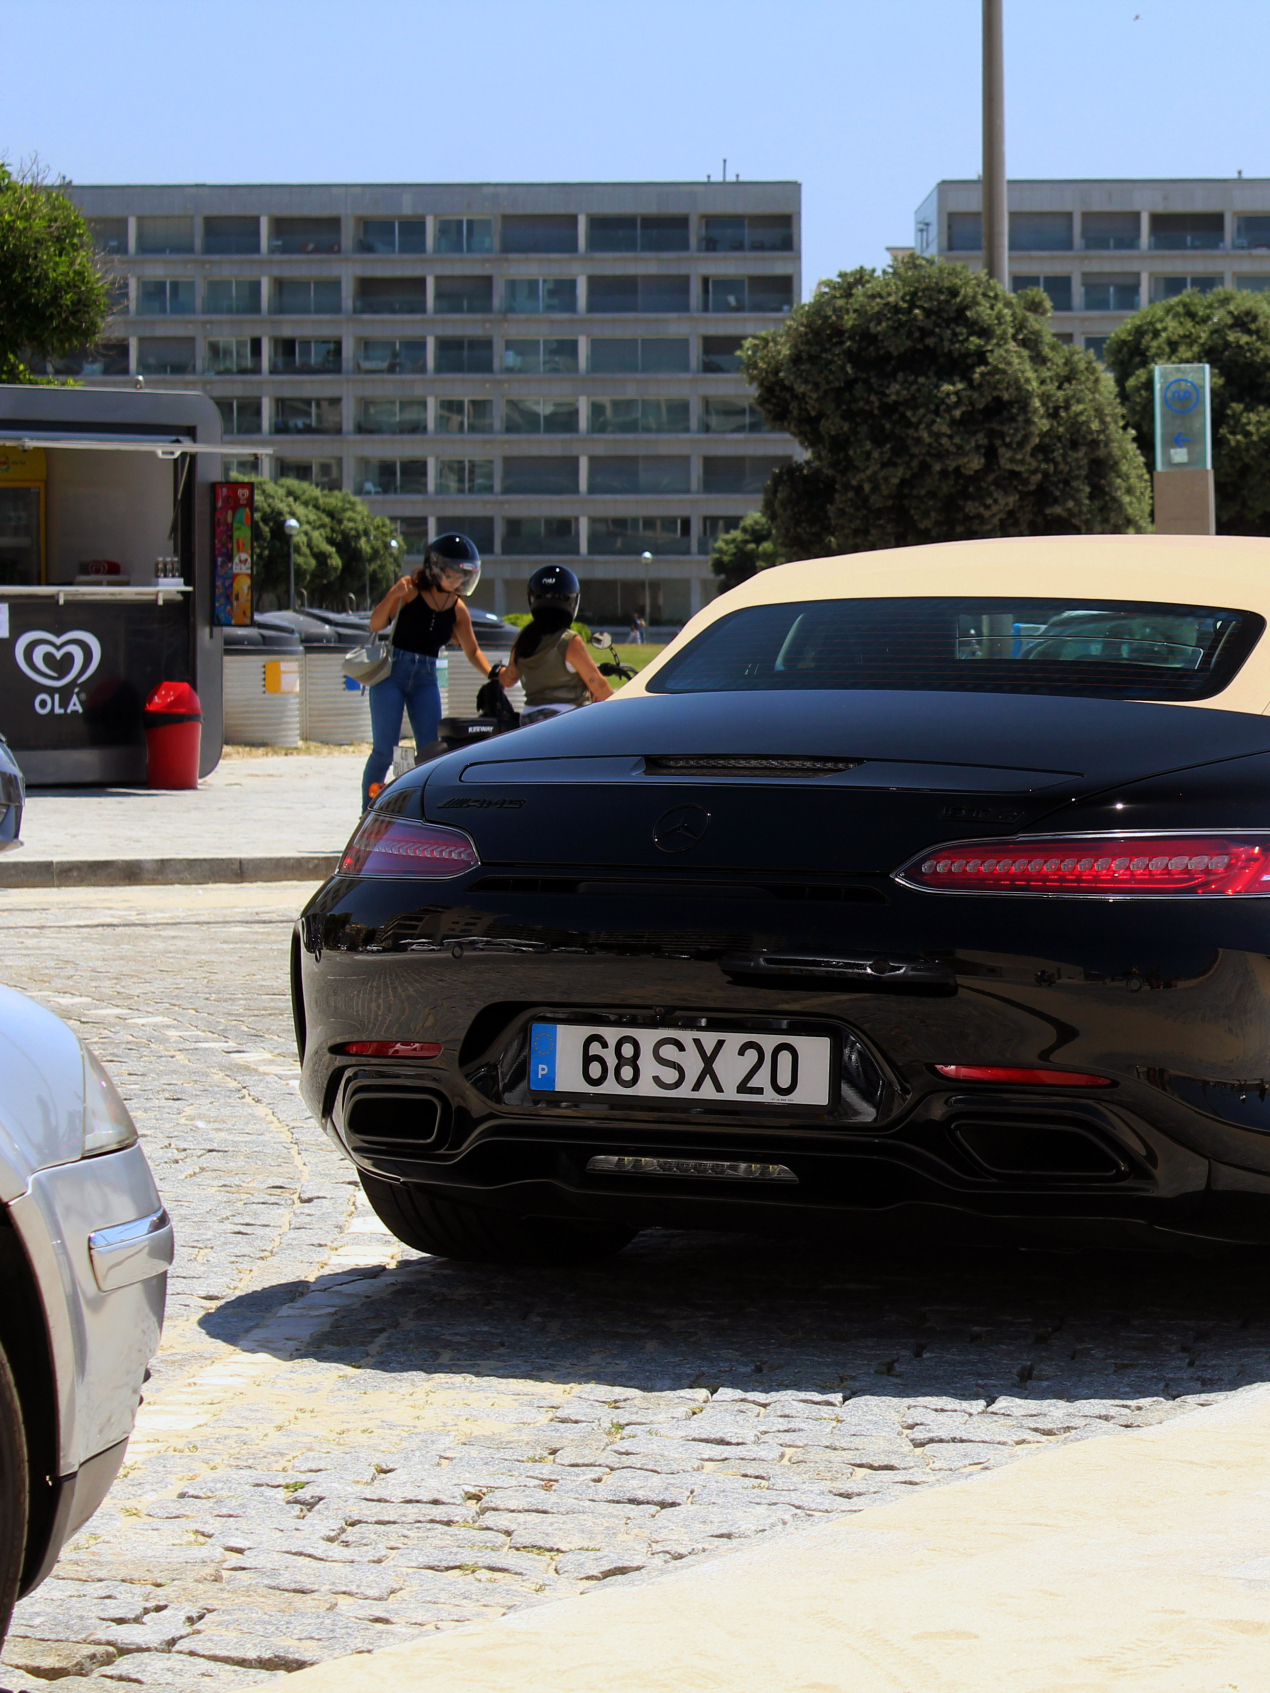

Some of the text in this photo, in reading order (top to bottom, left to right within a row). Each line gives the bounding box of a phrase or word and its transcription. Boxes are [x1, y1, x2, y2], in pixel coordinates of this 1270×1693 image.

[34, 686, 83, 715] OLÁ
[468, 726, 494, 734] KEEWAY
[537, 1064, 548, 1079] P
